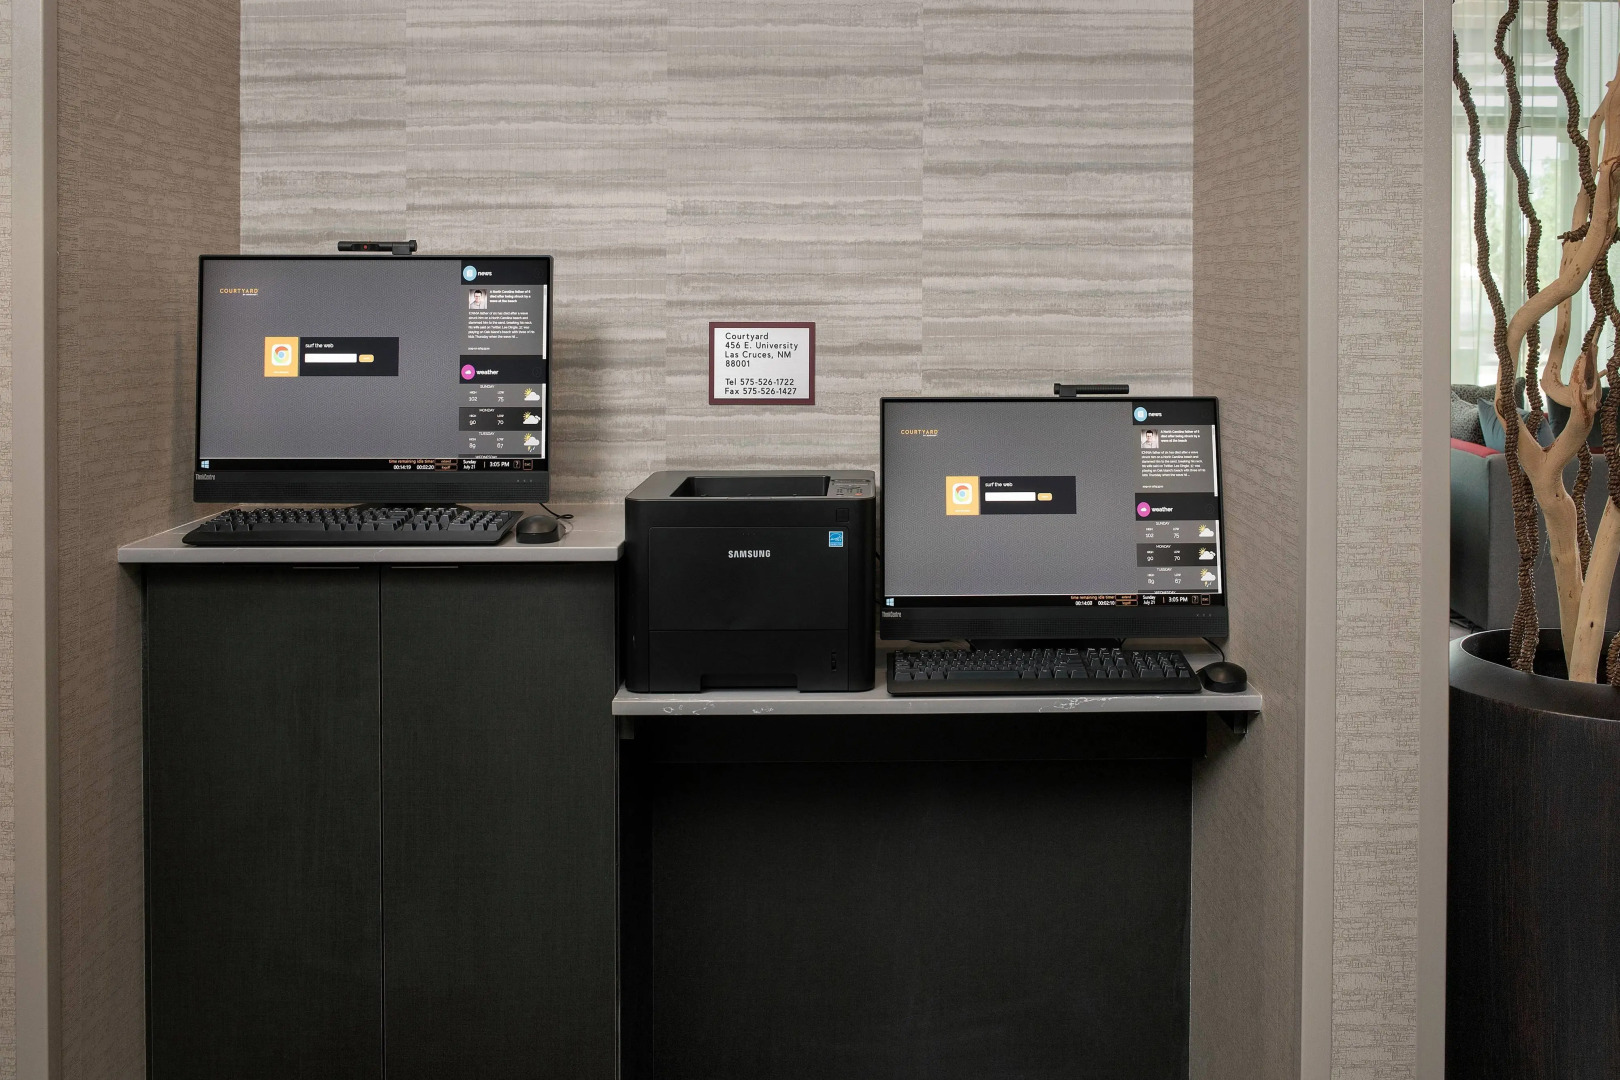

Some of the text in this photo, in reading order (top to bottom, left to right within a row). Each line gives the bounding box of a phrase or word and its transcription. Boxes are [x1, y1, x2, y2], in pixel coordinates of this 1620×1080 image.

[725, 332, 768, 341] Courtyard
[756, 342, 798, 350] University
[742, 351, 774, 359] Cruces,
[728, 550, 771, 558] SAMSUNG
